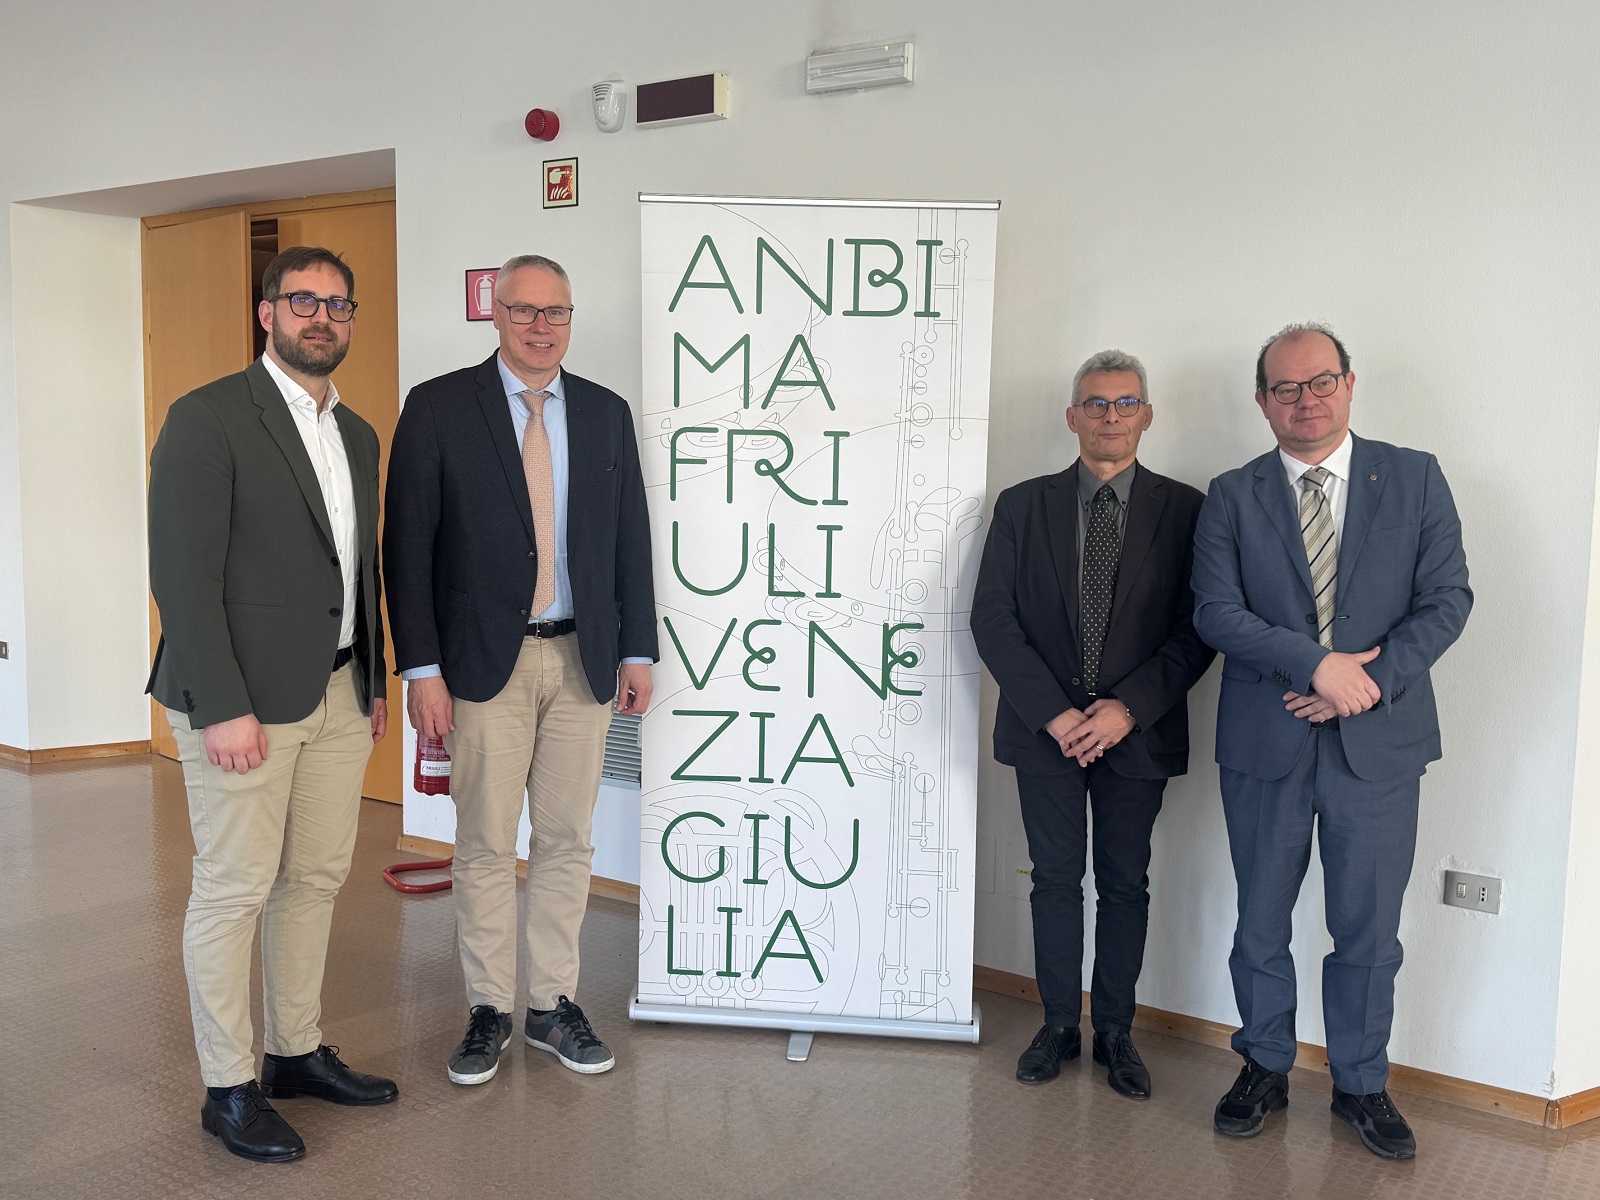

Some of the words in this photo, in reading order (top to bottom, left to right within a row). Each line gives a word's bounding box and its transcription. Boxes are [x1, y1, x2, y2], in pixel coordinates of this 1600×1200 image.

[669, 234, 943, 318] ANBI
[673, 332, 835, 411] MA
[669, 426, 850, 506] FRI
[672, 521, 843, 599] ULI
[663, 616, 925, 701] VENE
[671, 709, 855, 788] ZIA
[660, 811, 860, 890] GIU
[666, 904, 824, 984] LIA
